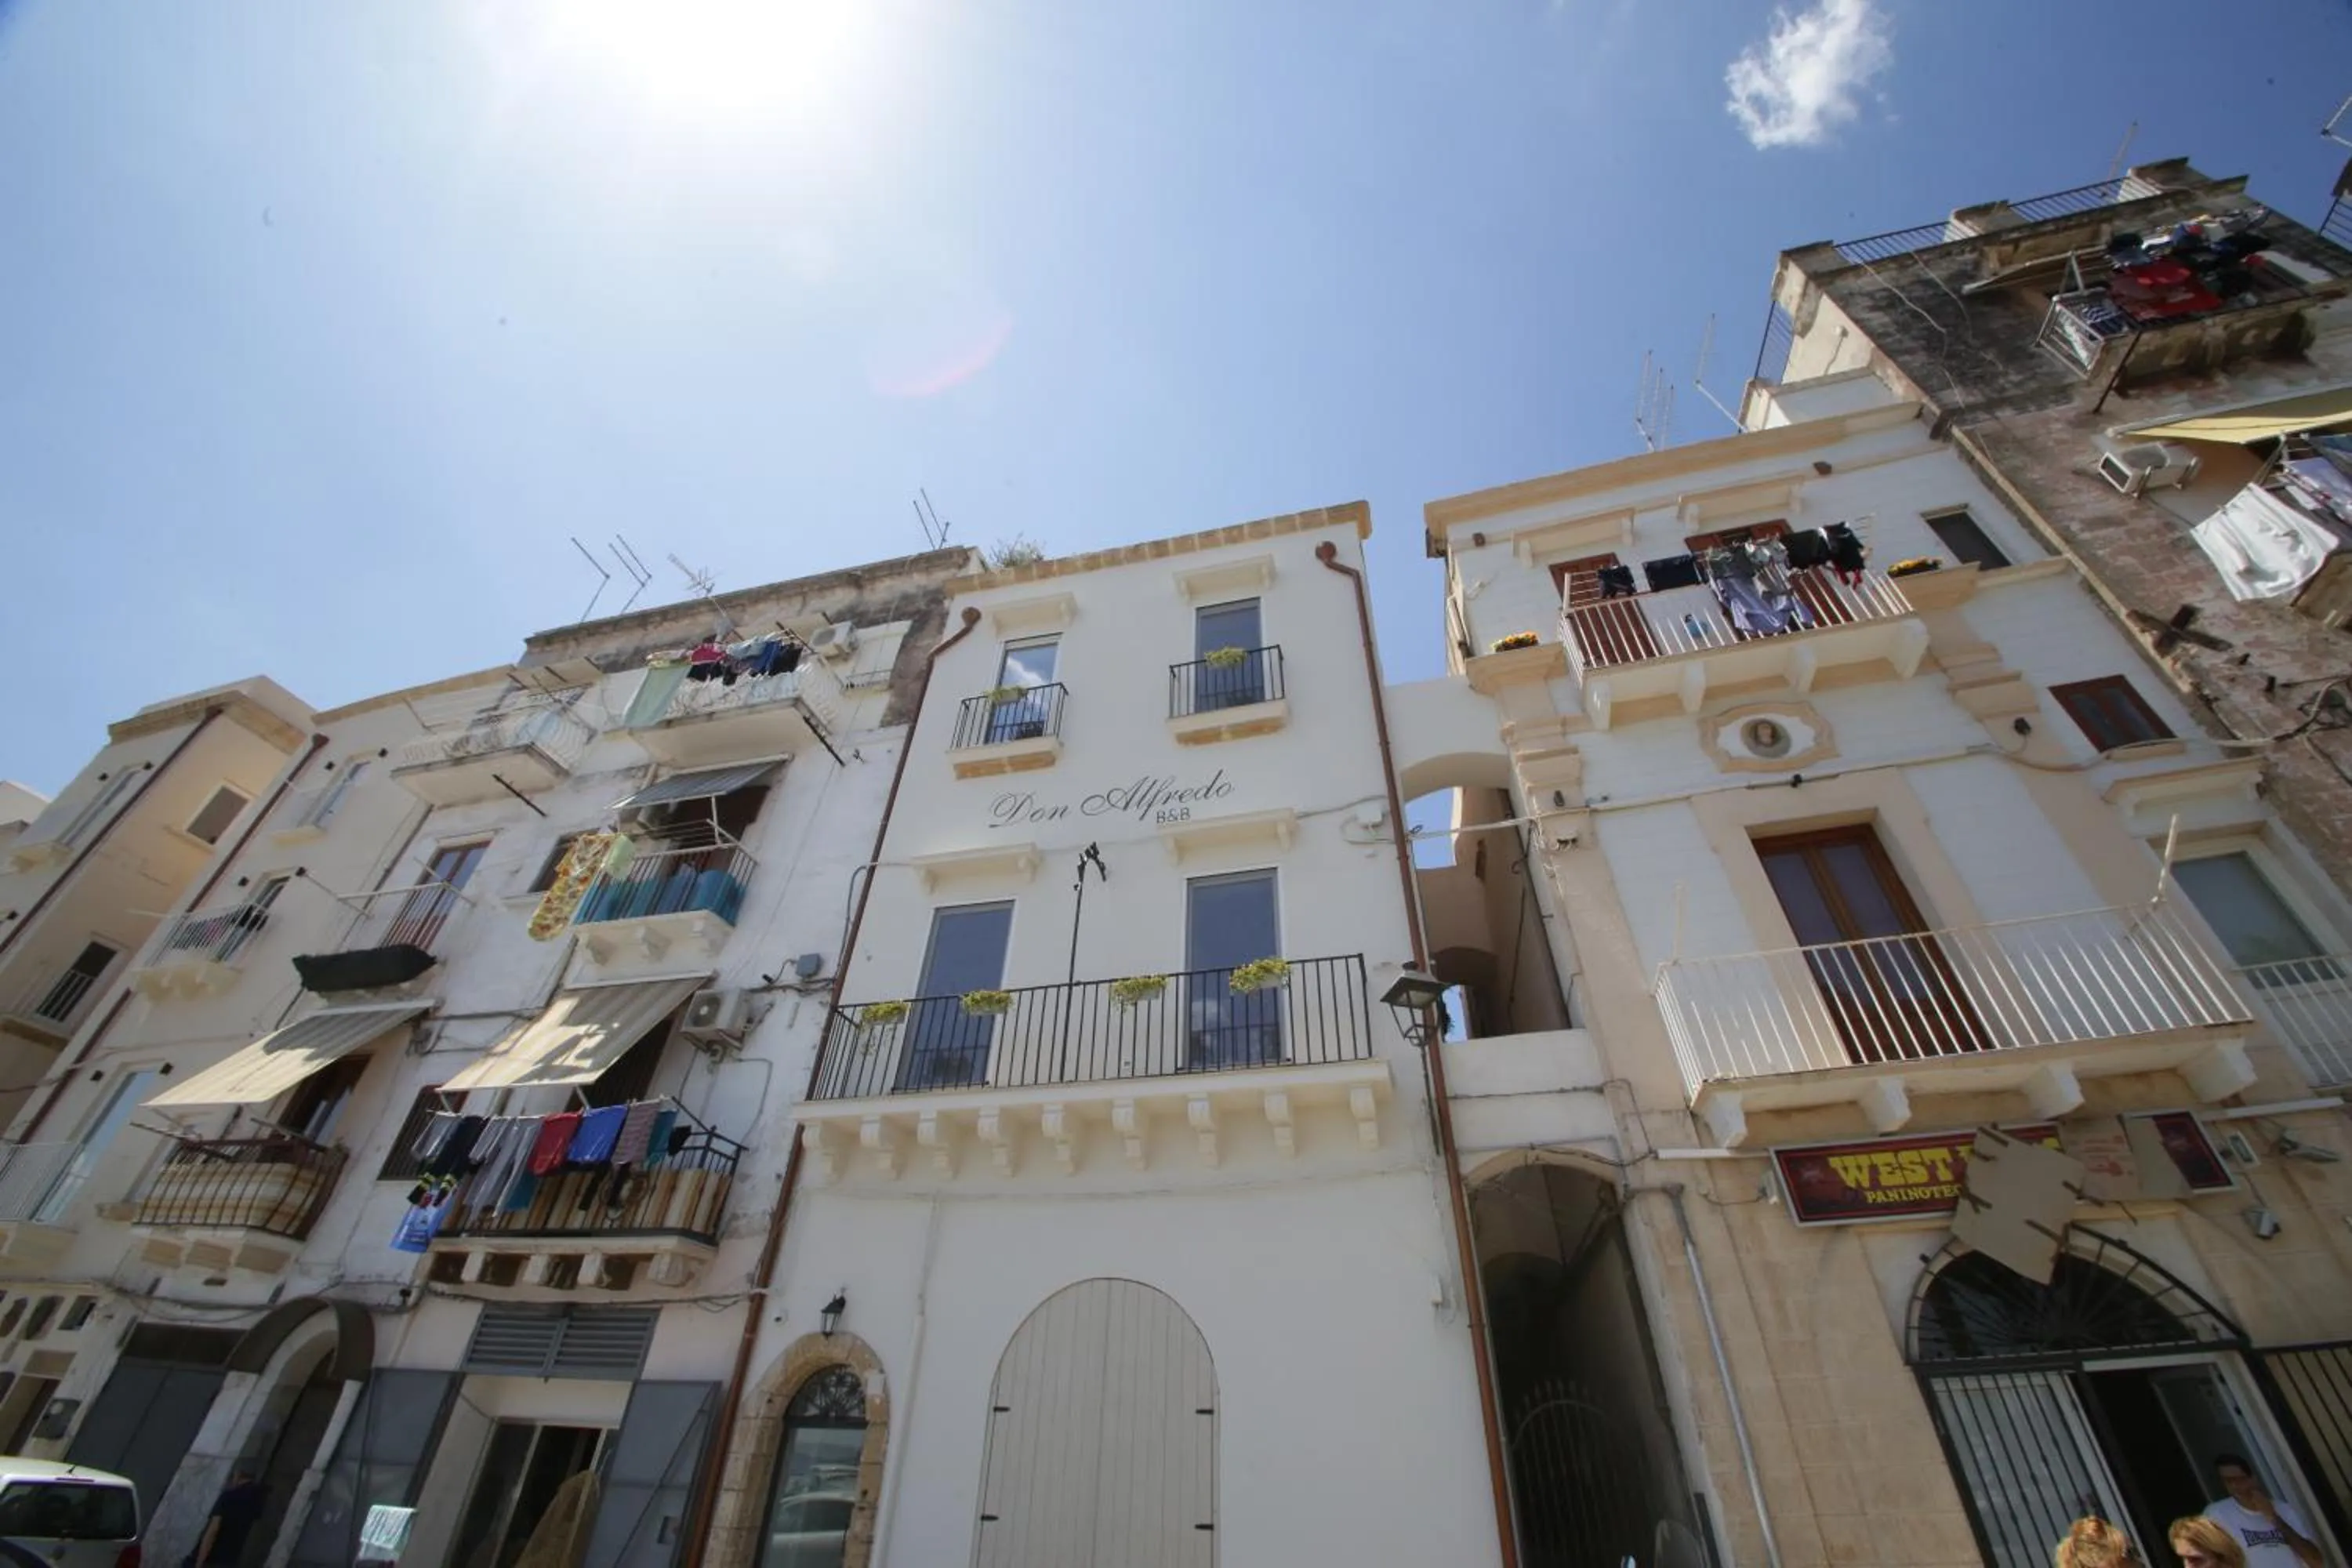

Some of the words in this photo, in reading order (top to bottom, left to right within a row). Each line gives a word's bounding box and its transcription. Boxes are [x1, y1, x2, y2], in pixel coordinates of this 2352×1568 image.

[989, 790, 1069, 828] Don
[1080, 769, 1235, 821] Alfredo
[1156, 808, 1191, 824] B&B
[1827, 1147, 1955, 1189] WEST
